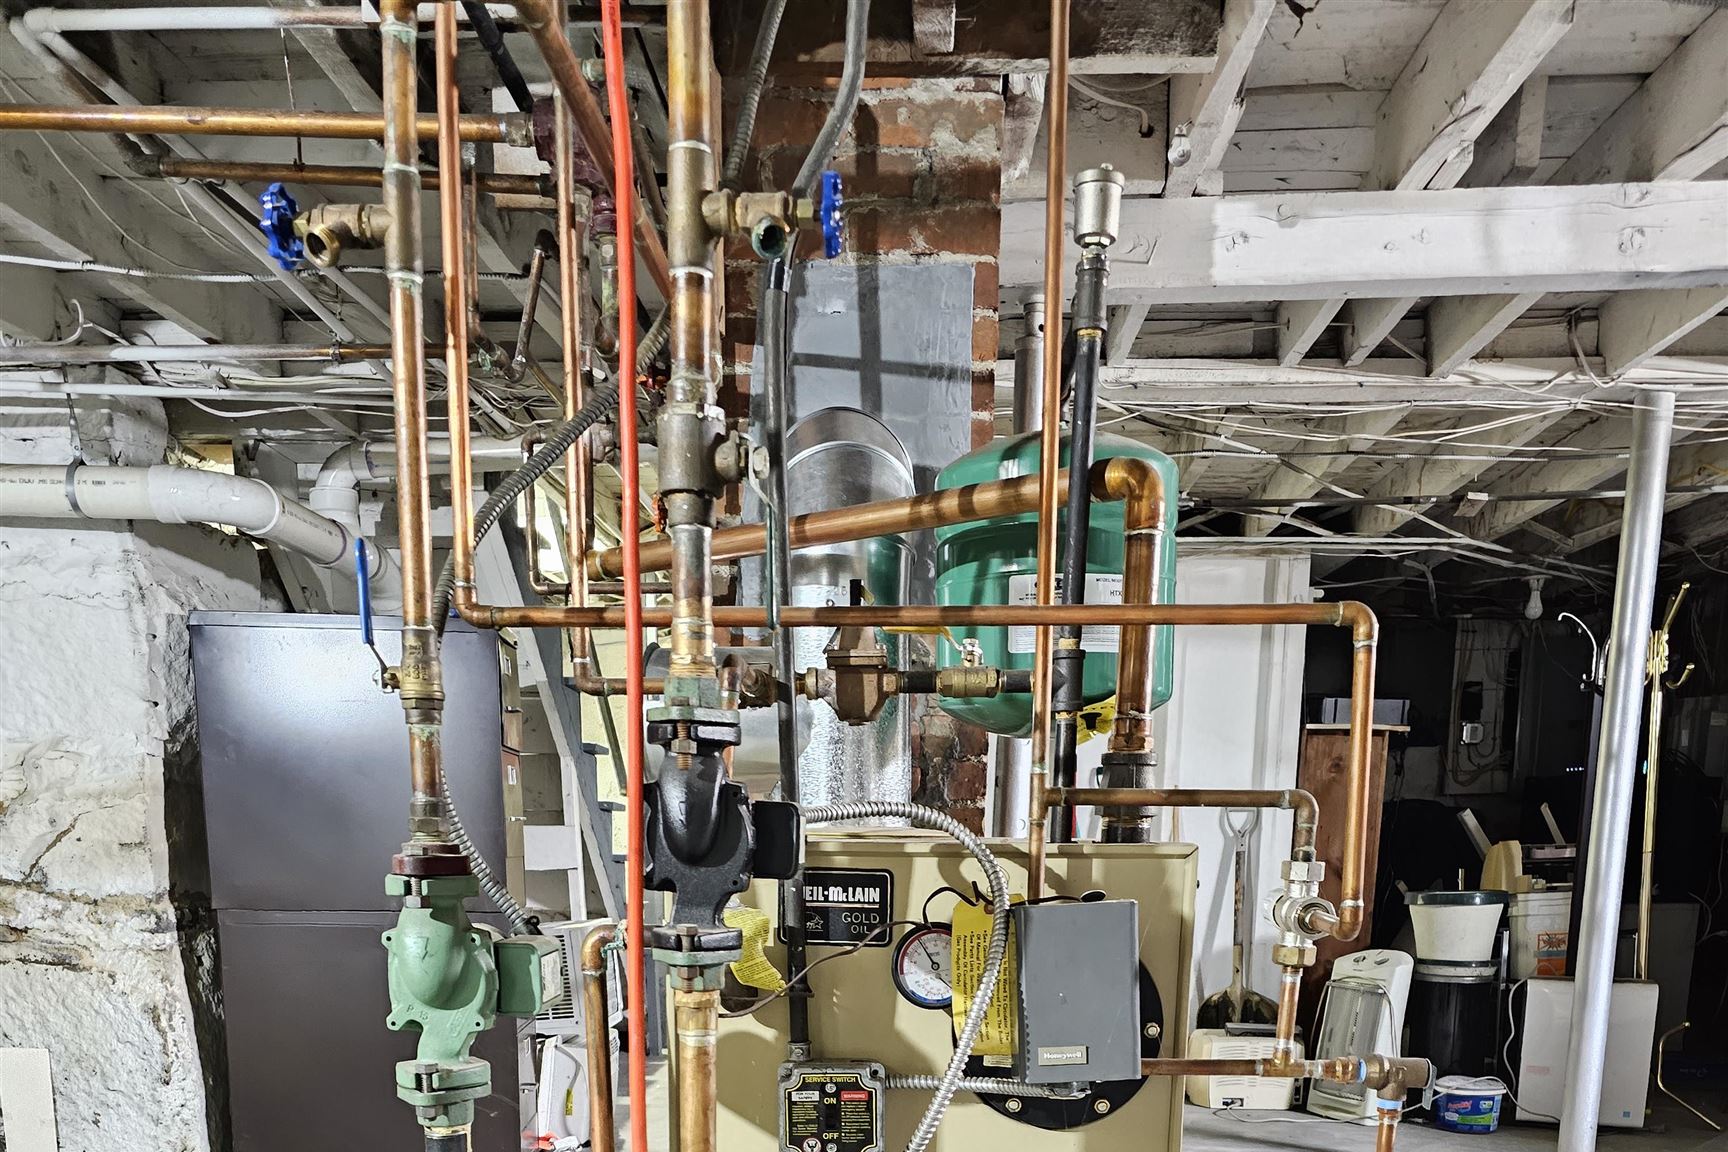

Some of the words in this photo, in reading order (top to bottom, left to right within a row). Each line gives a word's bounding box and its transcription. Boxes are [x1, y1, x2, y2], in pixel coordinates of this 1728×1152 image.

[841, 912, 880, 924] GOLD
[850, 924, 872, 934] OIL
[1043, 1051, 1082, 1060] Honeywell
[822, 1132, 839, 1140] OFF
